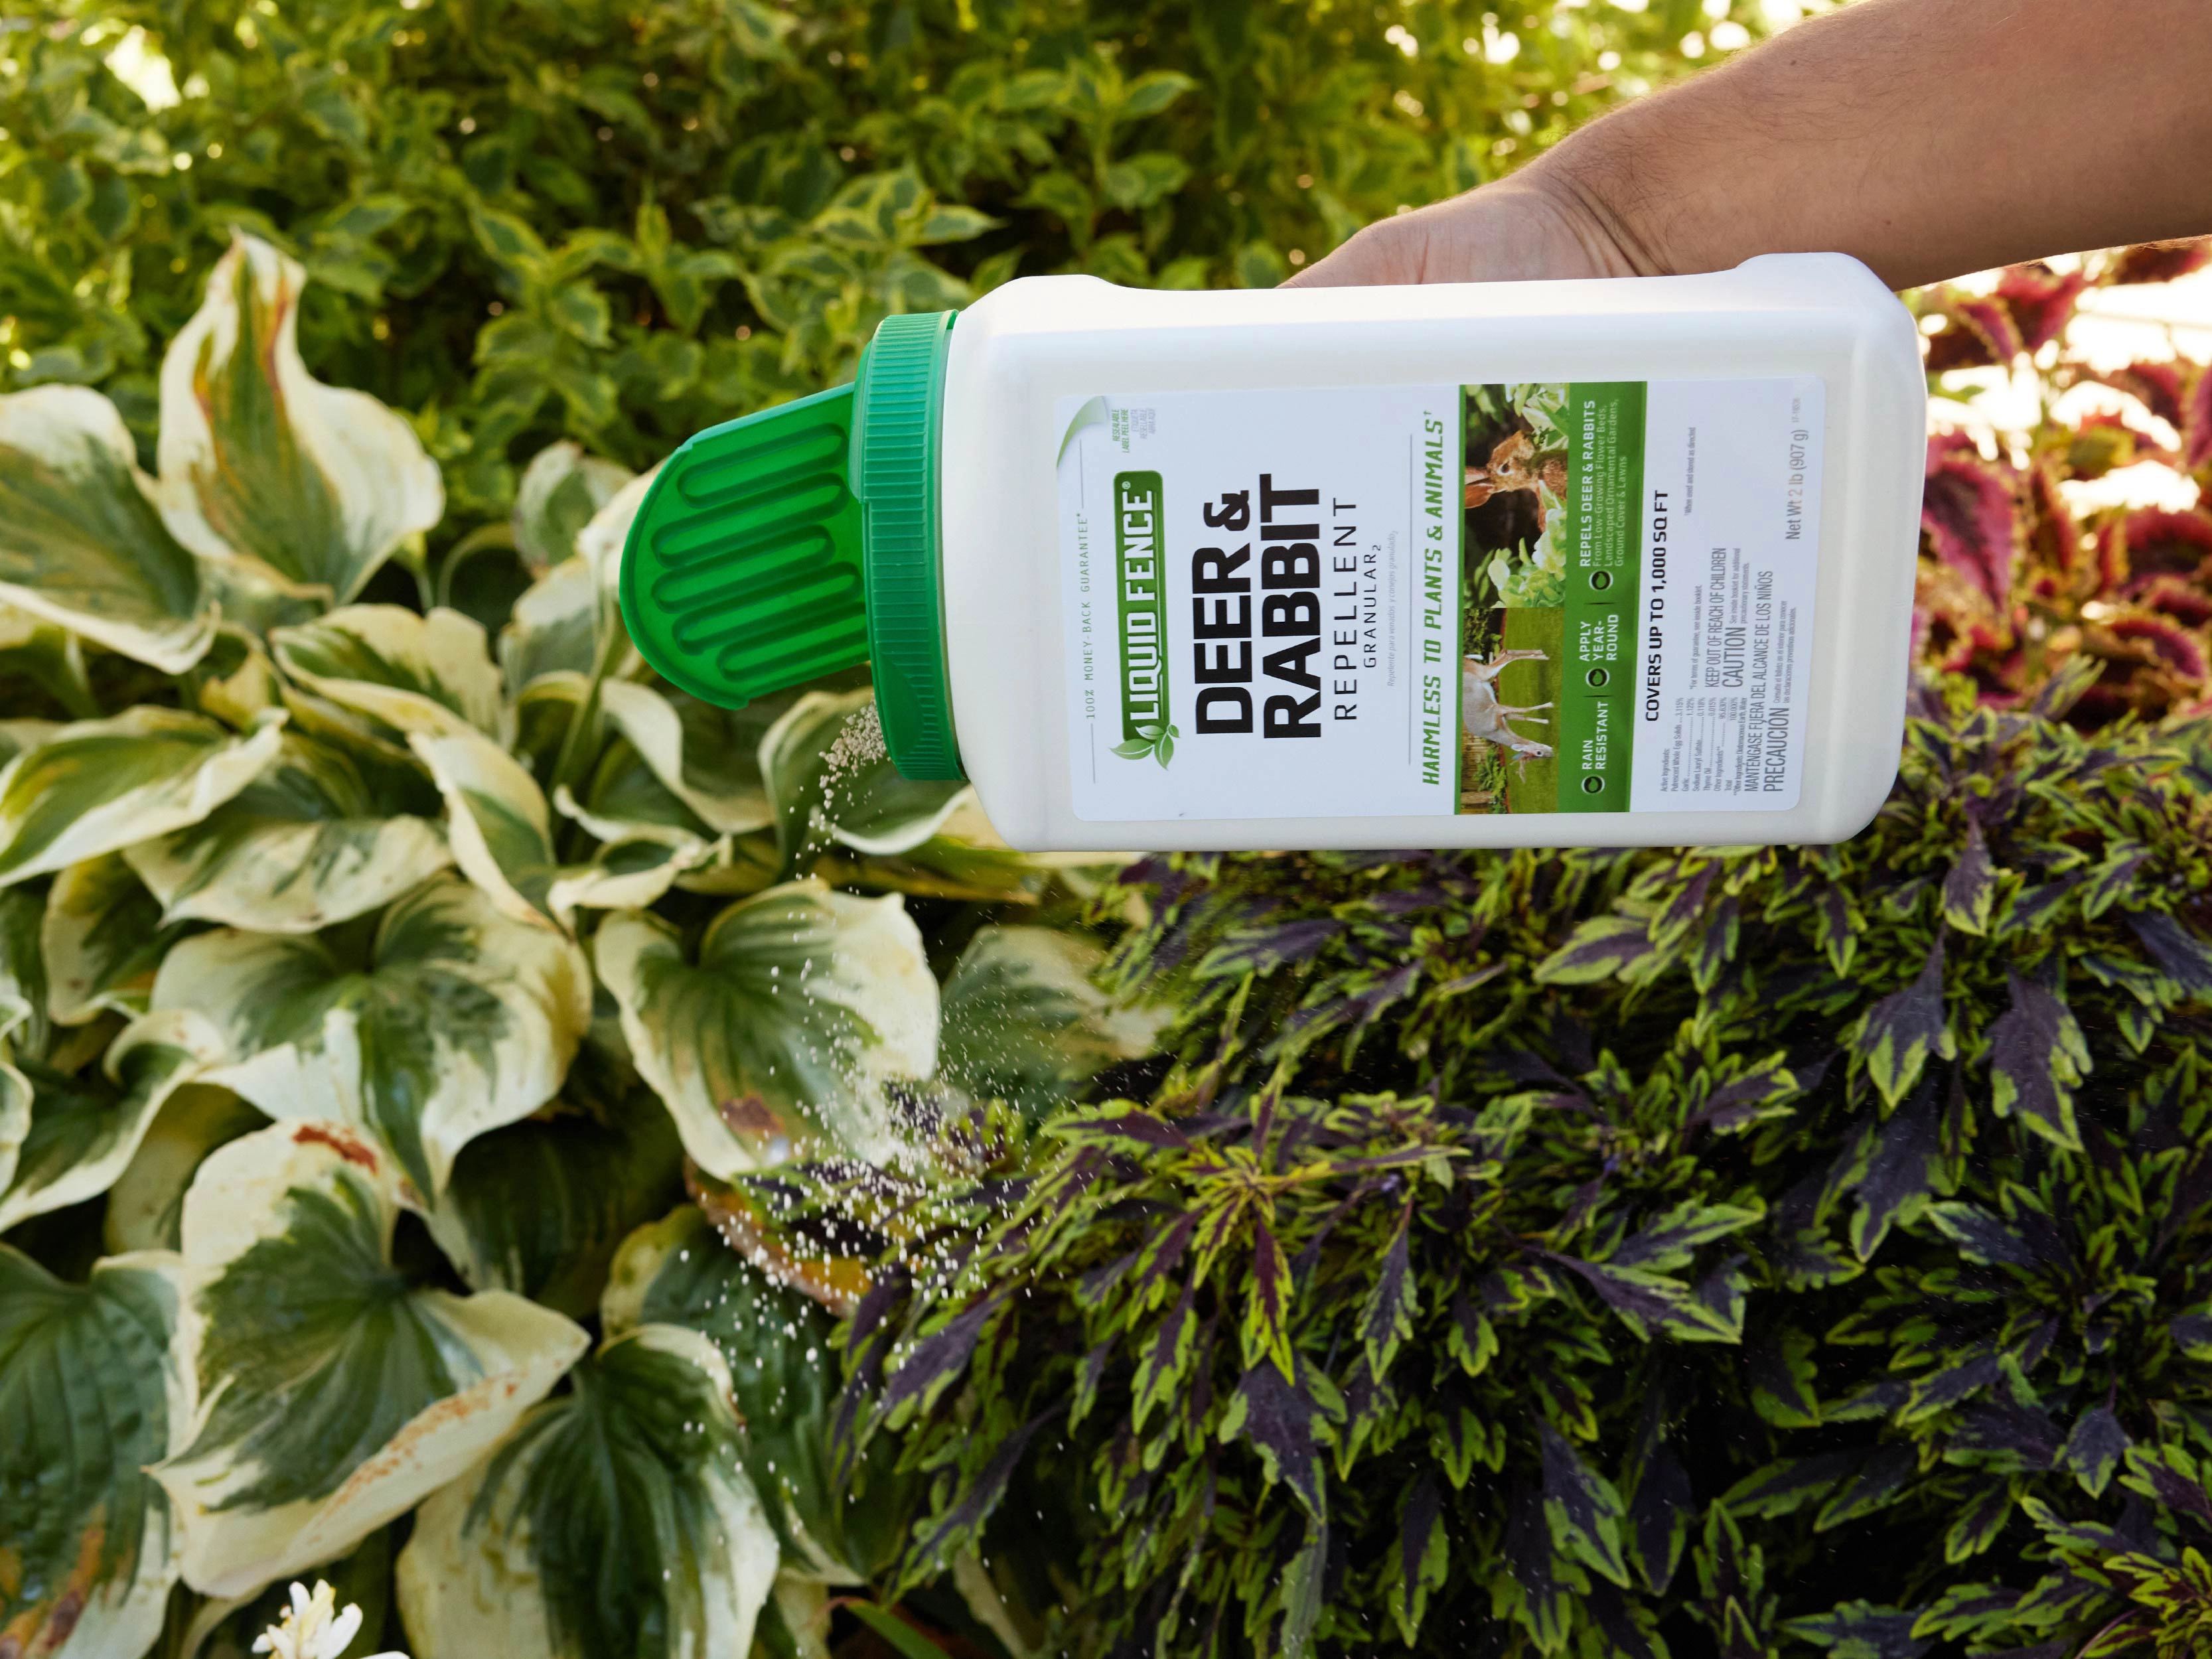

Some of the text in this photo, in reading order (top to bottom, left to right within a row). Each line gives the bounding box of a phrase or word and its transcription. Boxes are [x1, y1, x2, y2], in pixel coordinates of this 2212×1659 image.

[1582, 400, 1595, 460] RABBITS
[1791, 429, 1808, 441] g)
[1617, 457, 1627, 488] Lawns
[1789, 443, 1808, 470] (907
[1581, 475, 1593, 512] DEER
[1593, 405, 1607, 567] From Low-Growing Flower Beds,
[1604, 398, 1619, 567] Landscaped Ornamental Gardens,
[1789, 474, 1803, 485] lb
[1616, 500, 1626, 528] Cover
[1786, 500, 1802, 516] Wt
[1426, 526, 1443, 541] &
[1580, 515, 1592, 567] REPELS
[1785, 519, 1801, 540] Net
[1615, 531, 1625, 567] Ground
[1122, 481, 1162, 720] LIQUID FENCE®
[1388, 571, 1396, 598] conejos
[1424, 547, 1443, 630] PLANTS
[1191, 490, 1253, 735] DEER &
[1259, 474, 1321, 739] RABBIT
[1333, 498, 1357, 721] REPELLENT
[1645, 490, 1668, 722] COVERS UP TO 1,000 SQ FT
[1705, 547, 1726, 687] KEEP OUT OF REACH OF CHILDREN
[1729, 615, 1737, 624] See
[1730, 599, 1738, 614] inside
[1082, 601, 1094, 680] MONEY-BACK
[1423, 639, 1442, 664] TO
[1580, 621, 1591, 662] APPLY
[1592, 620, 1604, 661] YEAR-
[1606, 614, 1619, 660] ROUND
[1387, 652, 1396, 687] Repelente
[1722, 627, 1746, 687] CAUTION
[1742, 571, 1773, 792] MANTÉNGASE FUERA DEL ALCANCE DE LOS NIÑOS
[1784, 664, 1793, 695] declaraciones
[1085, 689, 1096, 719] 100%
[1675, 697, 1684, 717] 3.115%
[1686, 697, 1695, 715] 1.122%
[1422, 676, 1441, 786] HARMLESS
[1595, 701, 1609, 770] RESISTANT
[1674, 725, 1682, 739] Solids
[1674, 740, 1683, 750] Egg
[1703, 776, 1712, 791] Thyme
[1708, 697, 1716, 716] 0.015%
[1763, 707, 1789, 792] PRECAUCIÓN
[1582, 740, 1593, 770] RAIN
